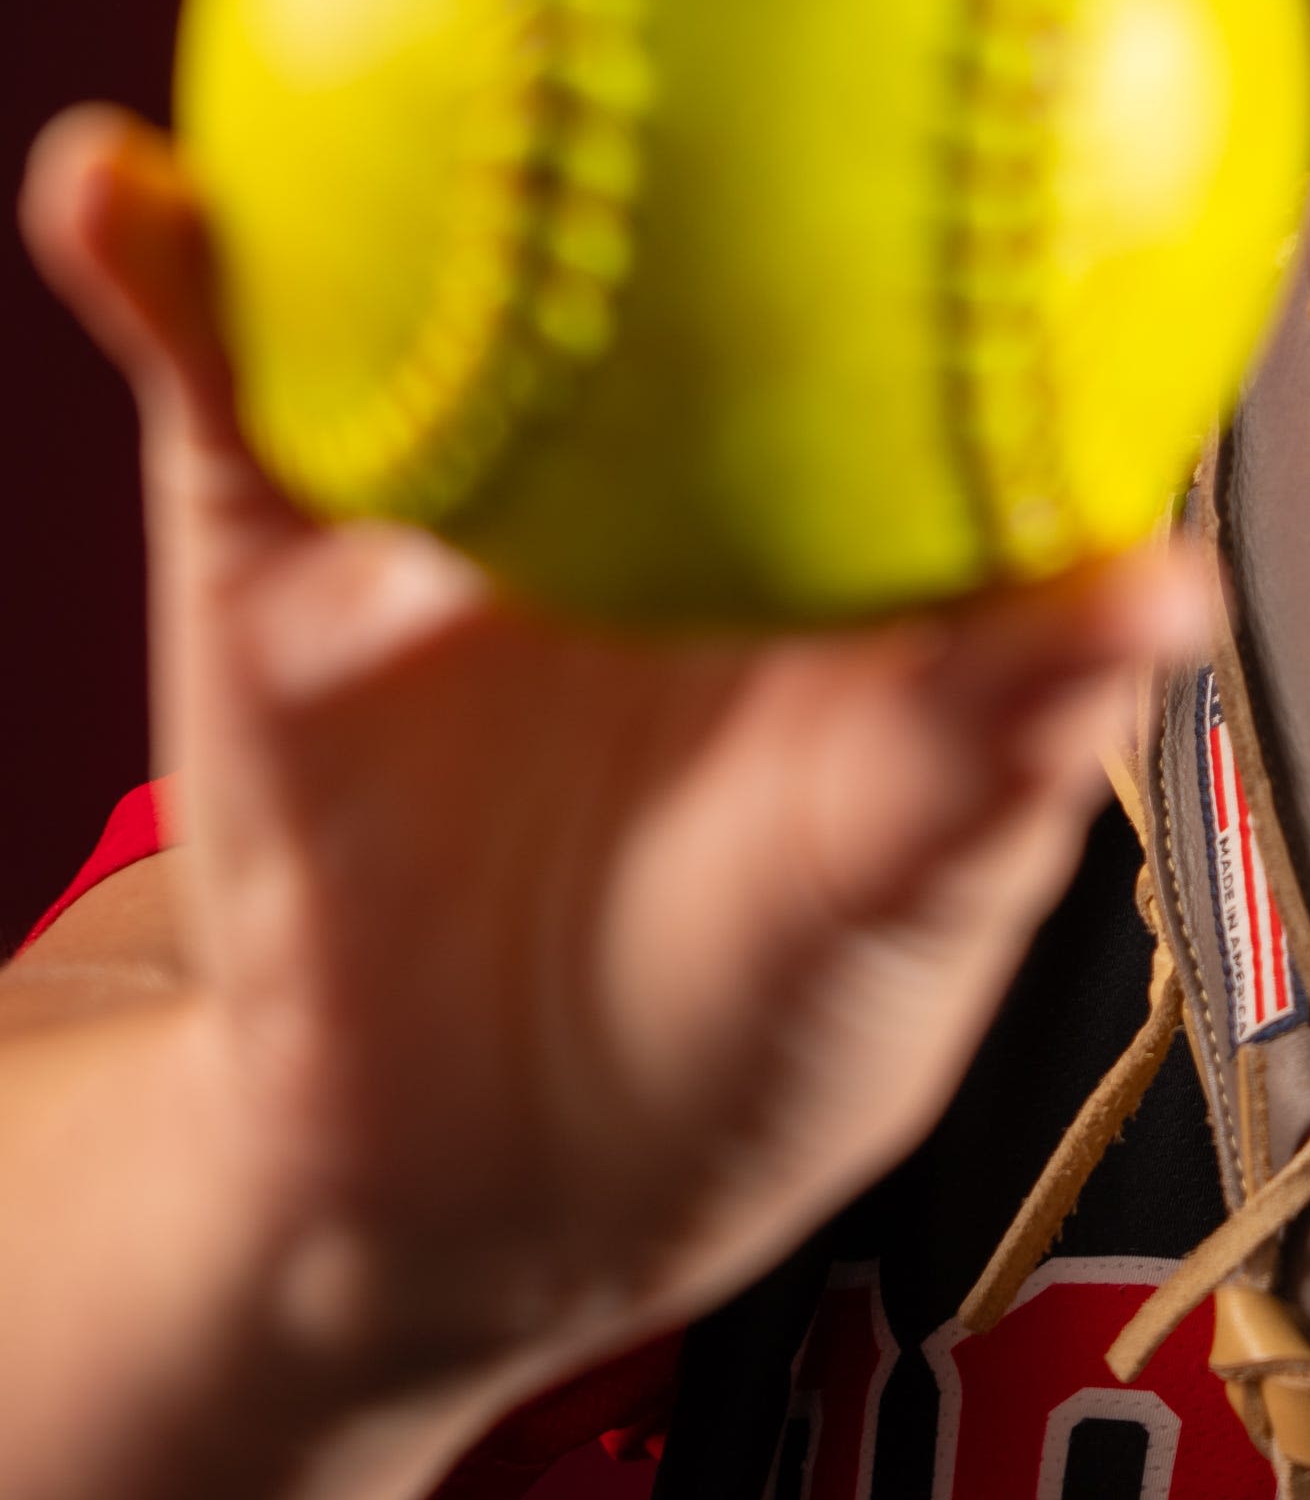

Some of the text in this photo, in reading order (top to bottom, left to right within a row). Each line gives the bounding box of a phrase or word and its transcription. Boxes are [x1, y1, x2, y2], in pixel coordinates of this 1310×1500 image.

[1219, 836, 1247, 1037] MADE IN AMERICA
